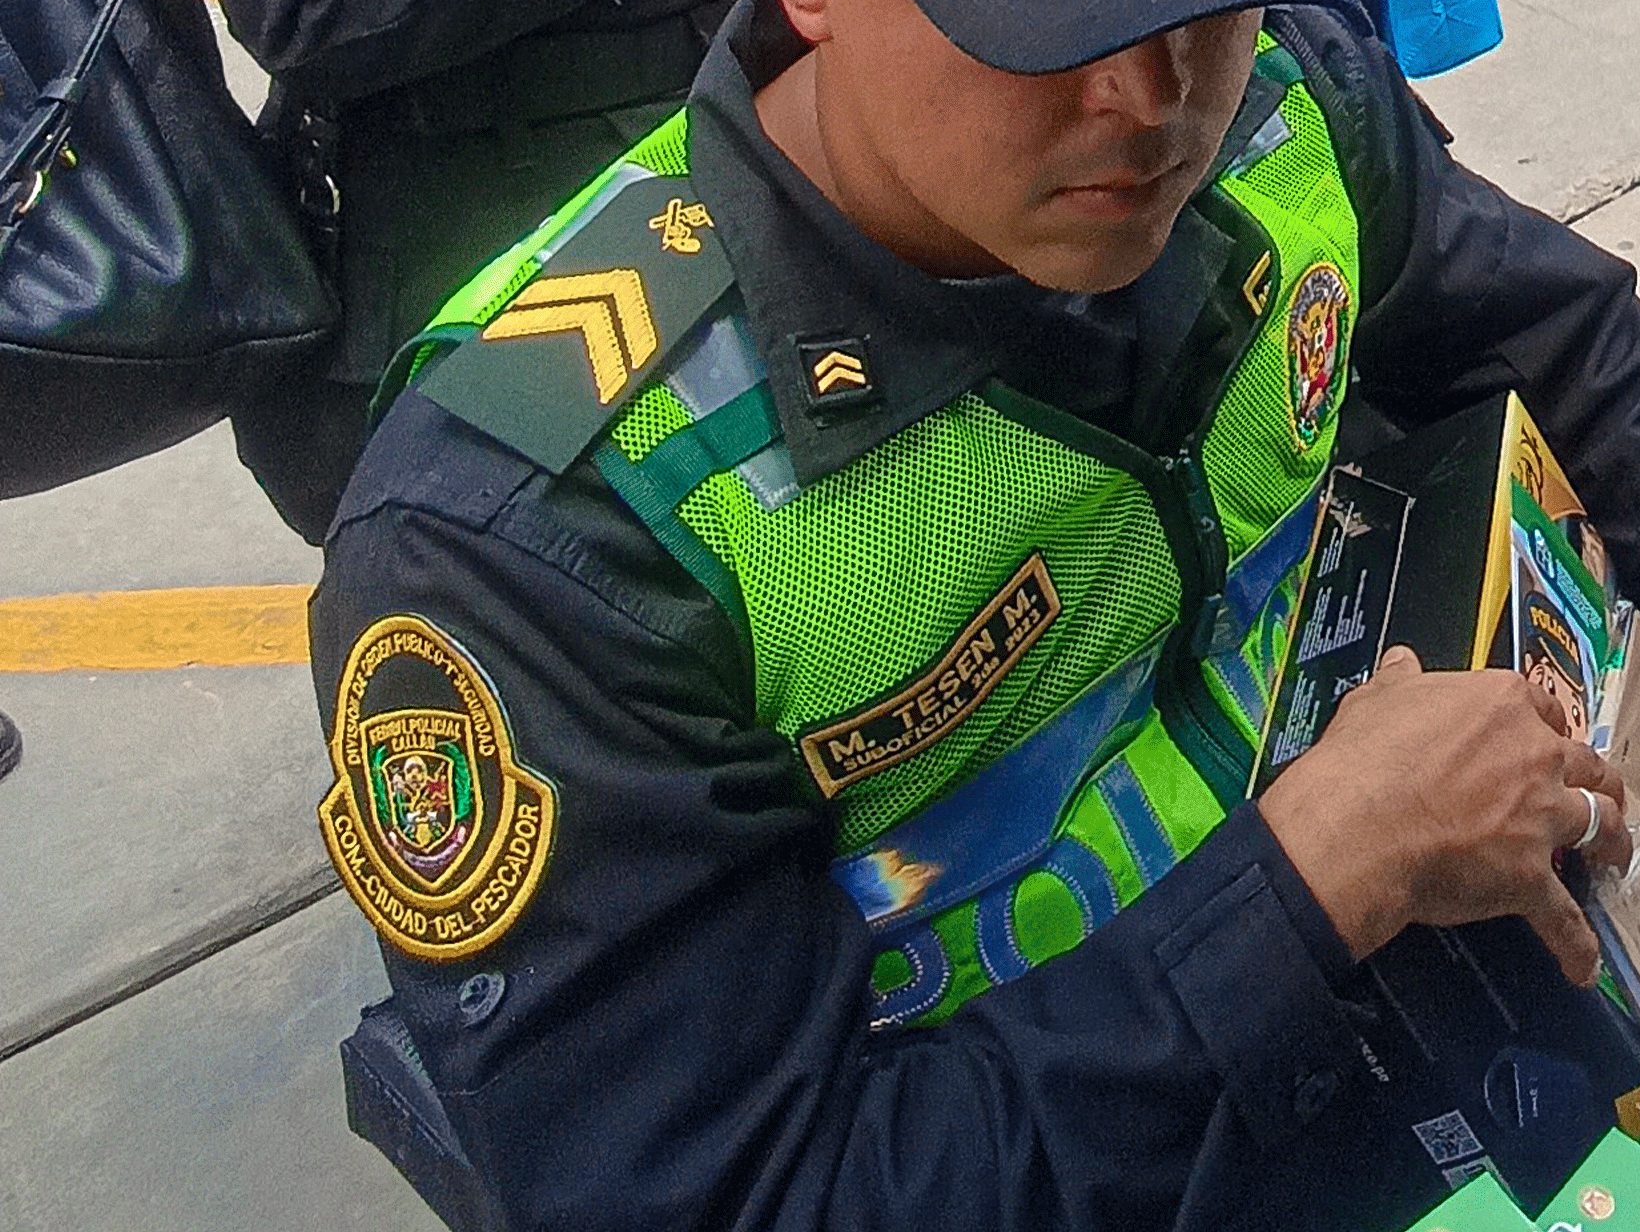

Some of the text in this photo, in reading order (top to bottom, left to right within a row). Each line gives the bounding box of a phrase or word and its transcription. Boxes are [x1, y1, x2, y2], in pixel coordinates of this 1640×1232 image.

[346, 695, 361, 765] DIVISION
[352, 671, 368, 699] DE
[453, 673, 496, 756] SEGURIDAD
[828, 586, 1041, 765] M. TESEN M.
[842, 697, 968, 772] SUBOFICIAL
[1003, 610, 1043, 654] 2023
[366, 874, 428, 936] CIUDAD
[433, 908, 473, 939] DEL
[470, 802, 540, 924] PESCADOR
